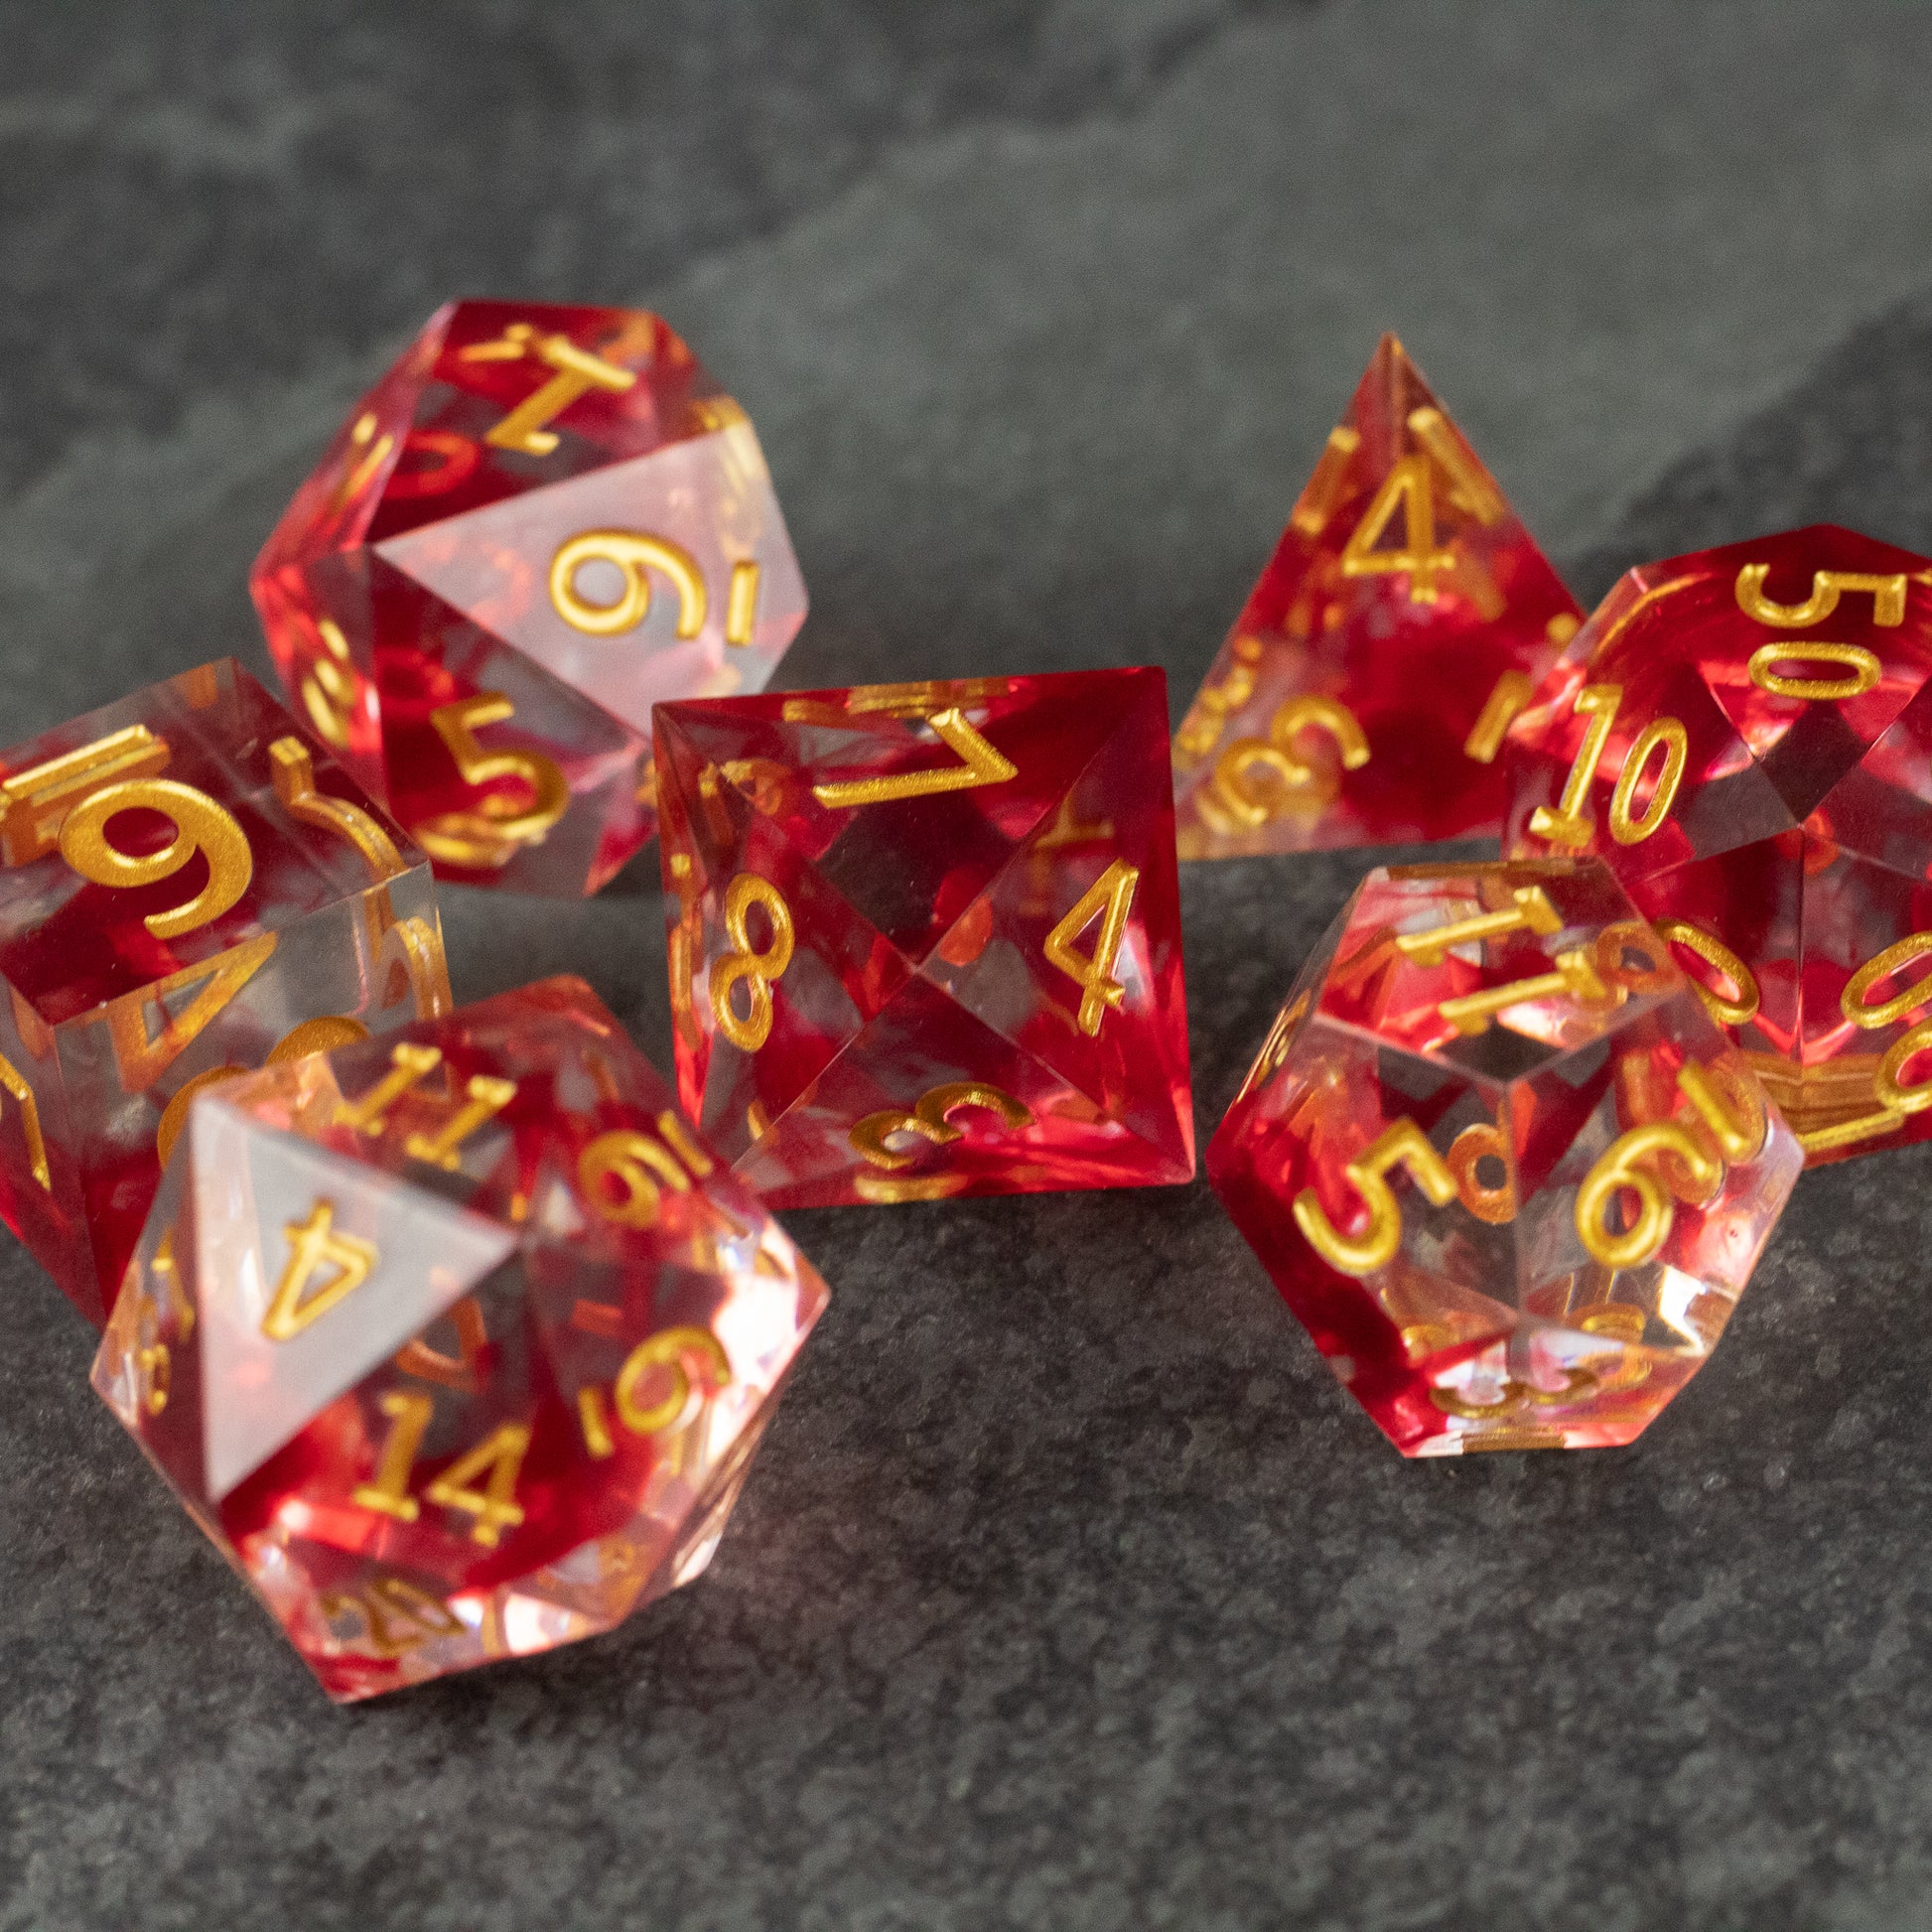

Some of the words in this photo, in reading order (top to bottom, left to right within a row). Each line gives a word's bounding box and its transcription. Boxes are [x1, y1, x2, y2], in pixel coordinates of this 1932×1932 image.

[1342, 455, 1456, 605] 4
[1734, 562, 1908, 701] 50
[429, 690, 570, 844] 5
[812, 708, 1019, 809] 7
[1529, 683, 1688, 846] 10
[709, 872, 795, 1052] 8
[1042, 857, 1140, 1037] 4
[1394, 885, 1610, 1036] 11
[332, 1042, 518, 1172] 11
[261, 1199, 379, 1342] 4
[1293, 1115, 1459, 1277] 5
[353, 1394, 534, 1550] 14
